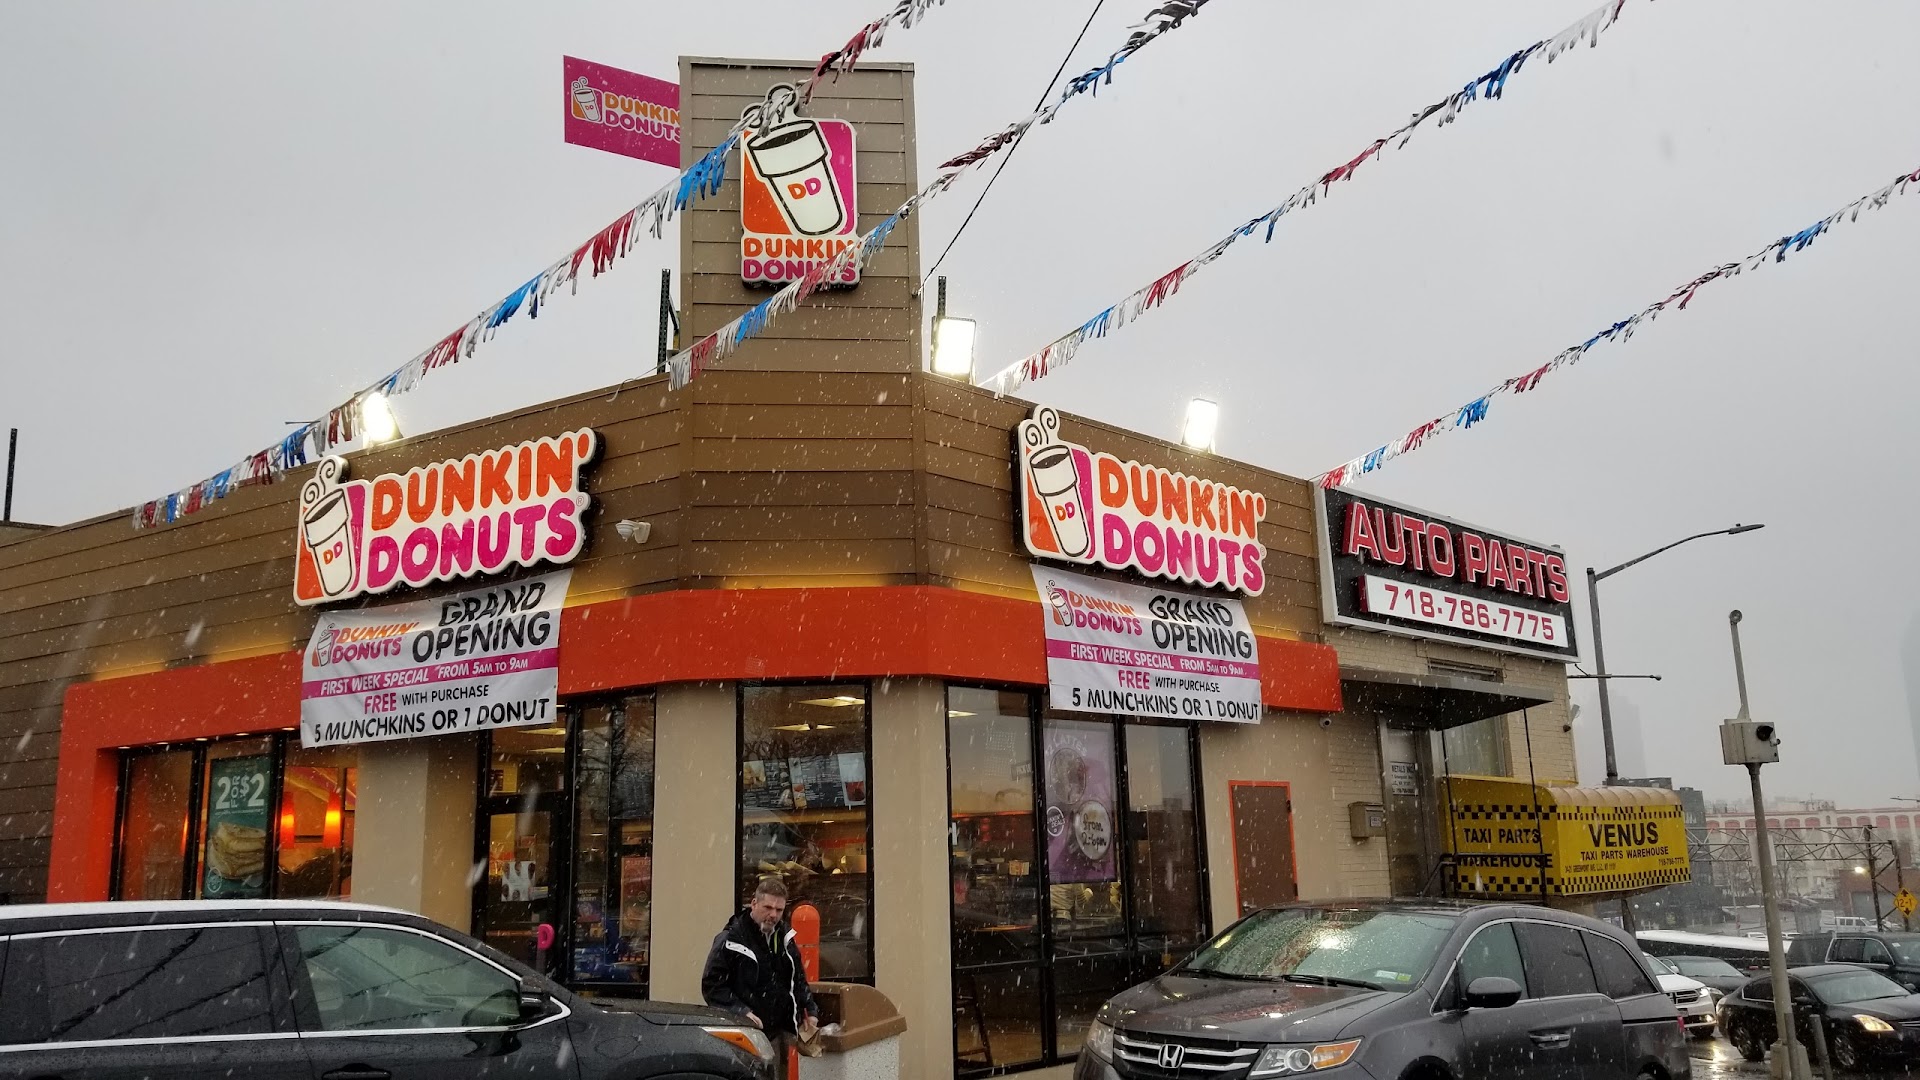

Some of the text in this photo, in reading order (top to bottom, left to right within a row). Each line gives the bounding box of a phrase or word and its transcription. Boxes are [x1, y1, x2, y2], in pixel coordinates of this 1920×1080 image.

[604, 92, 680, 124] DUNKIN
[787, 177, 822, 200] DD
[371, 433, 590, 532] DUNKIN'
[1098, 456, 1264, 540] DUNKIN'
[1055, 501, 1075, 521] DD
[323, 541, 343, 565] DD
[366, 498, 577, 588] DONUTS
[1102, 513, 1264, 592] DONUTS
[1345, 502, 1570, 603] AUTO PARTS
[438, 582, 546, 627] GRAND
[1069, 590, 1136, 616] DUNKIN'
[1149, 595, 1233, 627] GRAND
[336, 621, 420, 644] DUNKIN'
[412, 611, 551, 663] OPENING
[1074, 609, 1143, 636] DONUTS
[332, 636, 402, 663] DONUTS
[1151, 619, 1252, 659] OPENING
[1070, 643, 1098, 660] FIRST
[1101, 648, 1133, 665] WEEK
[1133, 652, 1174, 669] SPECIAL
[1180, 659, 1205, 672] FROM
[1220, 665, 1228, 674] TO
[320, 657, 529, 696] FIRST WEEK SPECIAL FROM 5AM TO 9AM
[1118, 669, 1221, 693] FREE WITH PURCHASE
[364, 684, 489, 714] FREE WITH PURCHASE
[1072, 687, 1259, 720] 5 MUNCHKINS OR 1 DONUT
[314, 698, 550, 743] 5 MUNCHKINS OR 1 DONUT
[215, 776, 231, 809] 2
[231, 775, 240, 808] FOR
[1463, 827, 1540, 844] TAXI PARTS
[1588, 821, 1659, 848] VENUS
[1457, 853, 1554, 868] WAREHOUSE
[1580, 845, 1670, 861] TAXI PARTS WAREHOUSE
